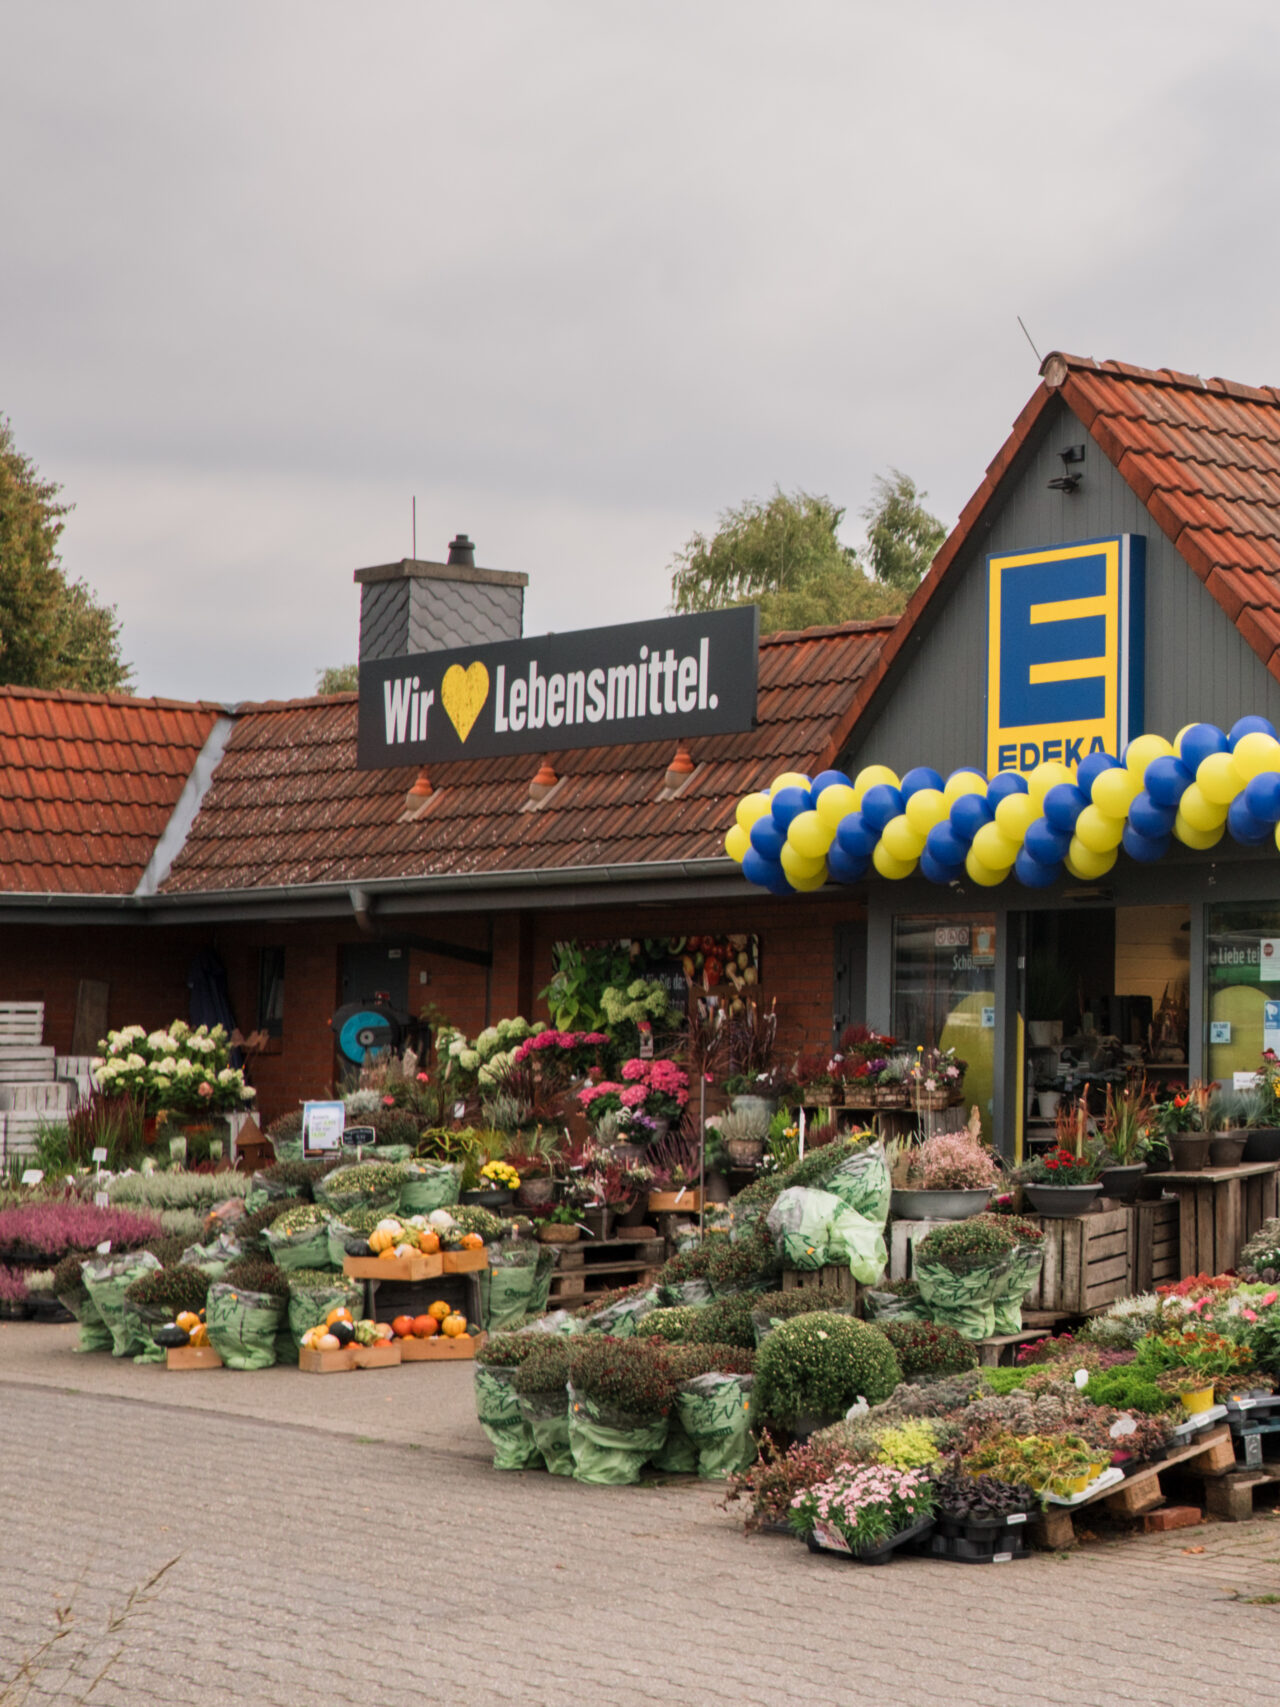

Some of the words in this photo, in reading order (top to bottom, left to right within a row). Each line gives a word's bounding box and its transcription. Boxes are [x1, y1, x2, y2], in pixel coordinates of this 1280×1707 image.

[384, 676, 434, 745] Wir
[494, 637, 719, 733] Lebensmittel.
[999, 553, 1106, 728] E
